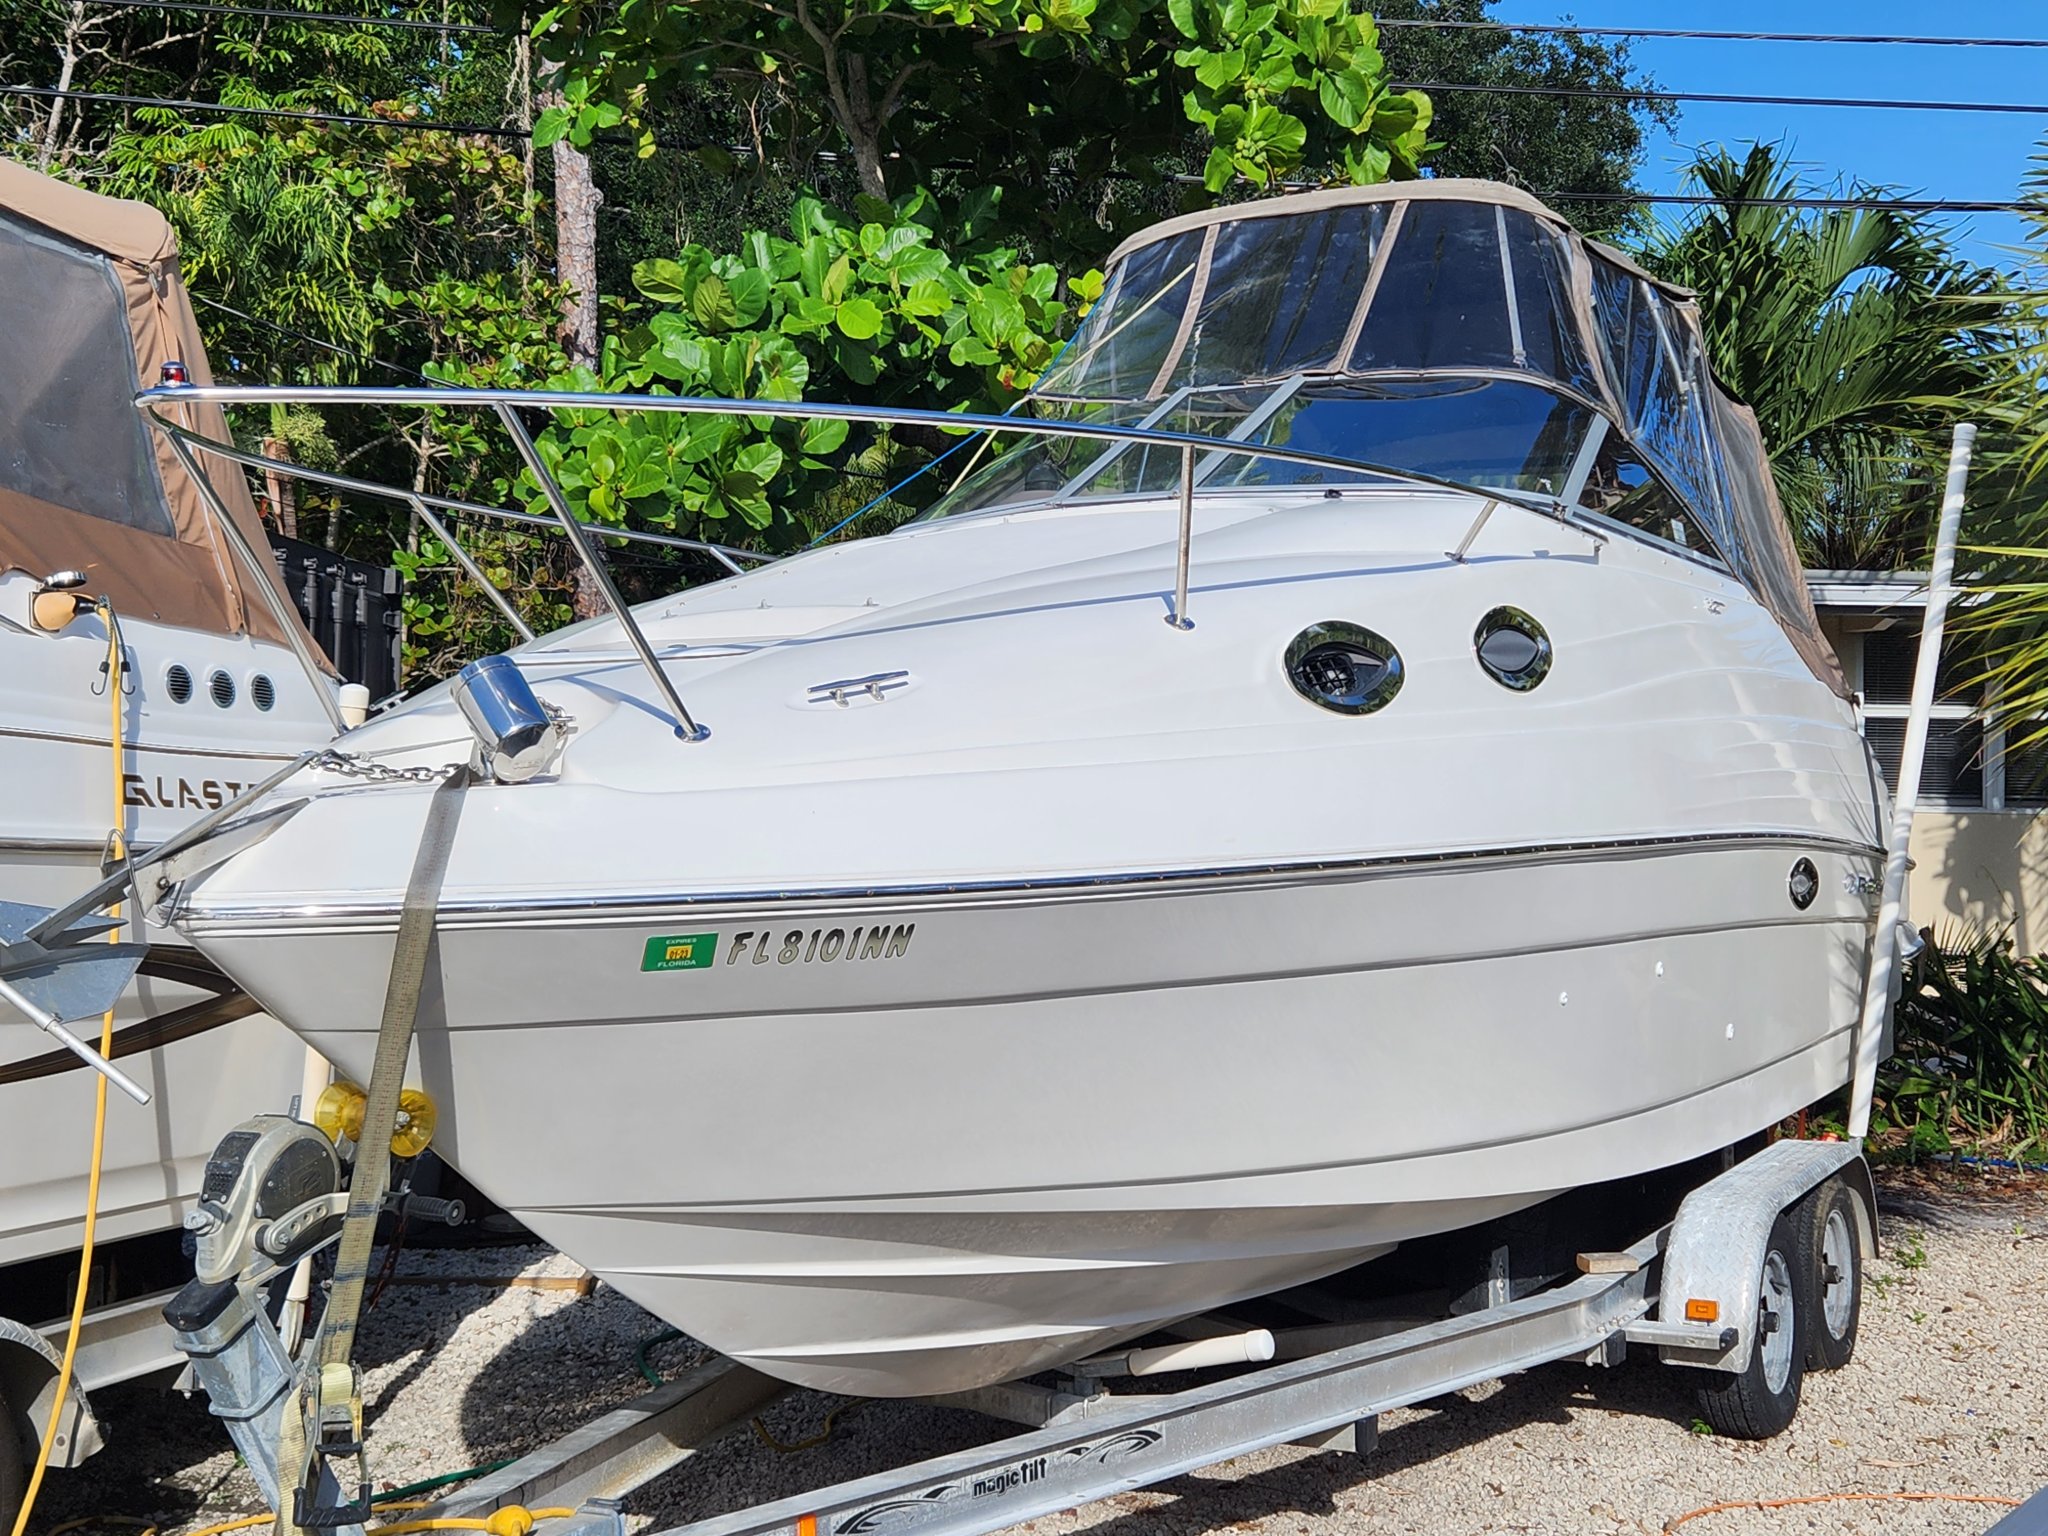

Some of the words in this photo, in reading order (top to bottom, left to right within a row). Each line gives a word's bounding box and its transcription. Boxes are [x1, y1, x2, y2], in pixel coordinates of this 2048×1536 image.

[122, 773, 258, 812] GLAST
[665, 937, 698, 945] EXPIRES
[657, 959, 697, 968] FLORIDA
